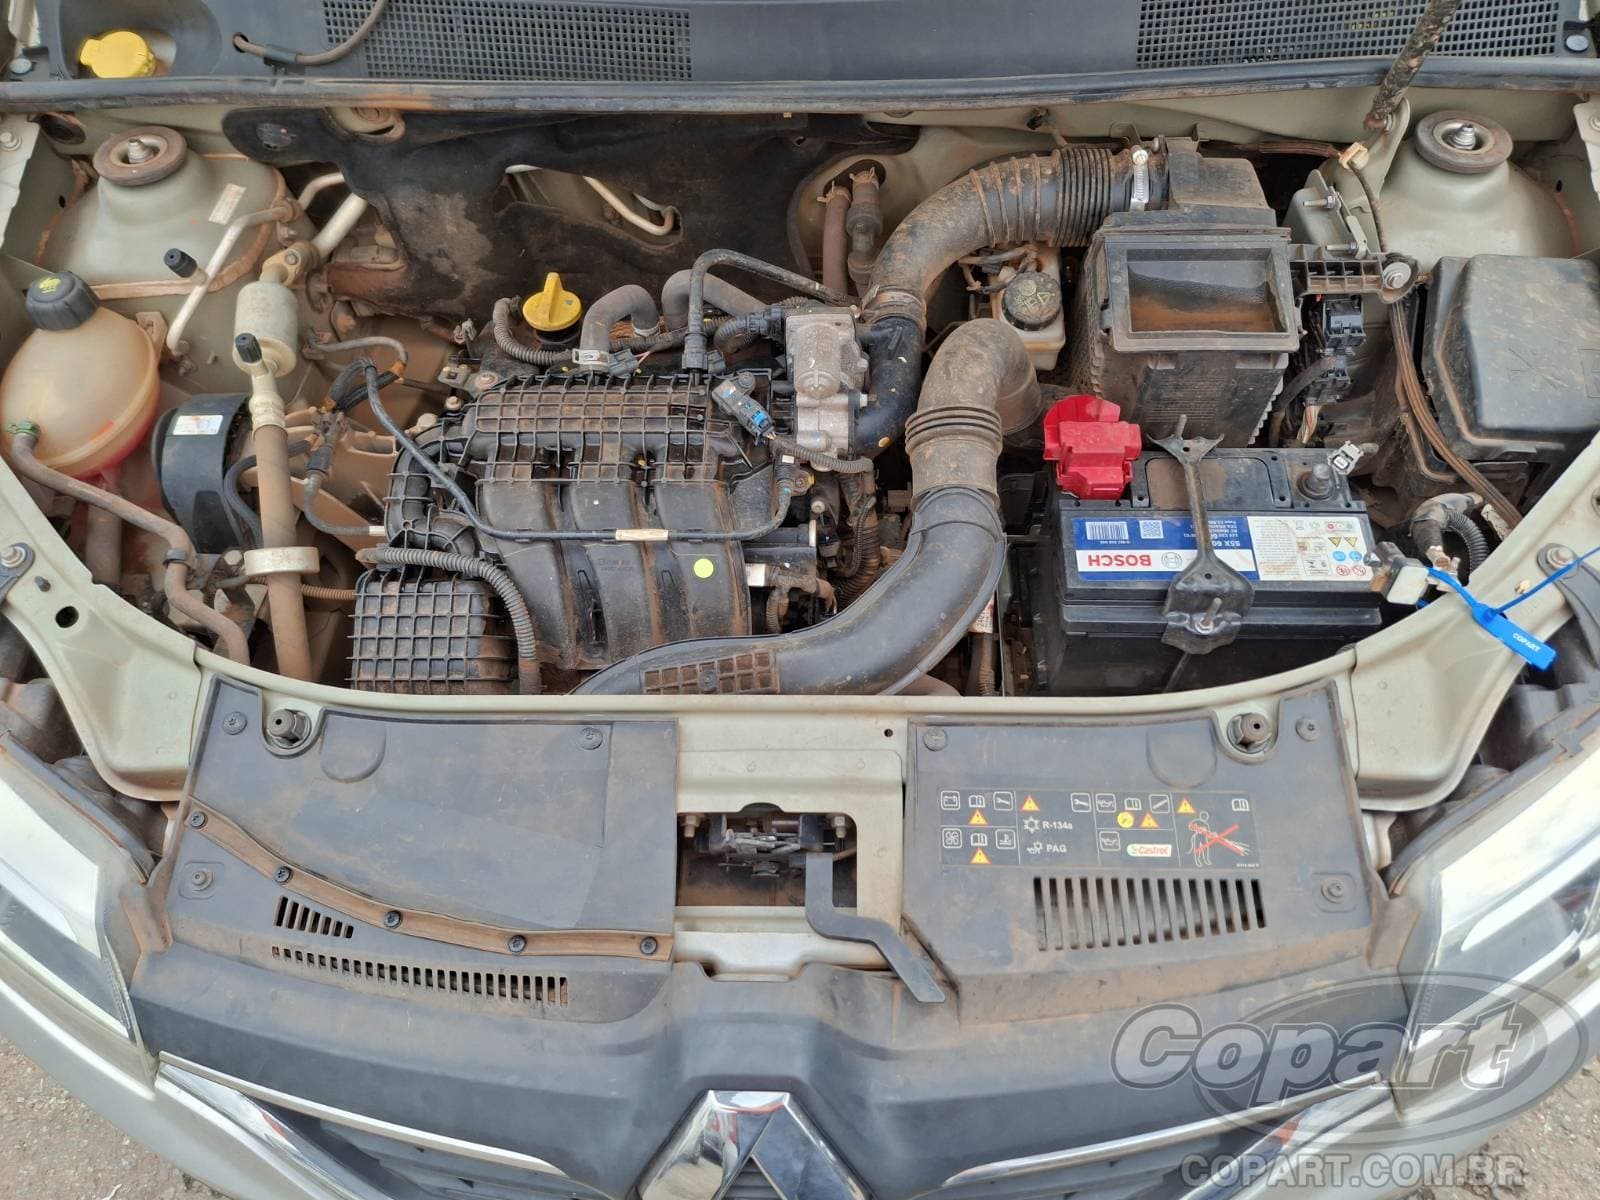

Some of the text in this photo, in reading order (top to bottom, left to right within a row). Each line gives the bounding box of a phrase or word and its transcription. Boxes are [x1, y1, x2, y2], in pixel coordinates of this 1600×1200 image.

[1087, 554, 1152, 567] BOSCH
[1513, 632, 1541, 652] COPART
[1042, 820, 1073, 830] R-134a
[1046, 844, 1067, 853] PAG
[1138, 846, 1168, 855] Castrol
